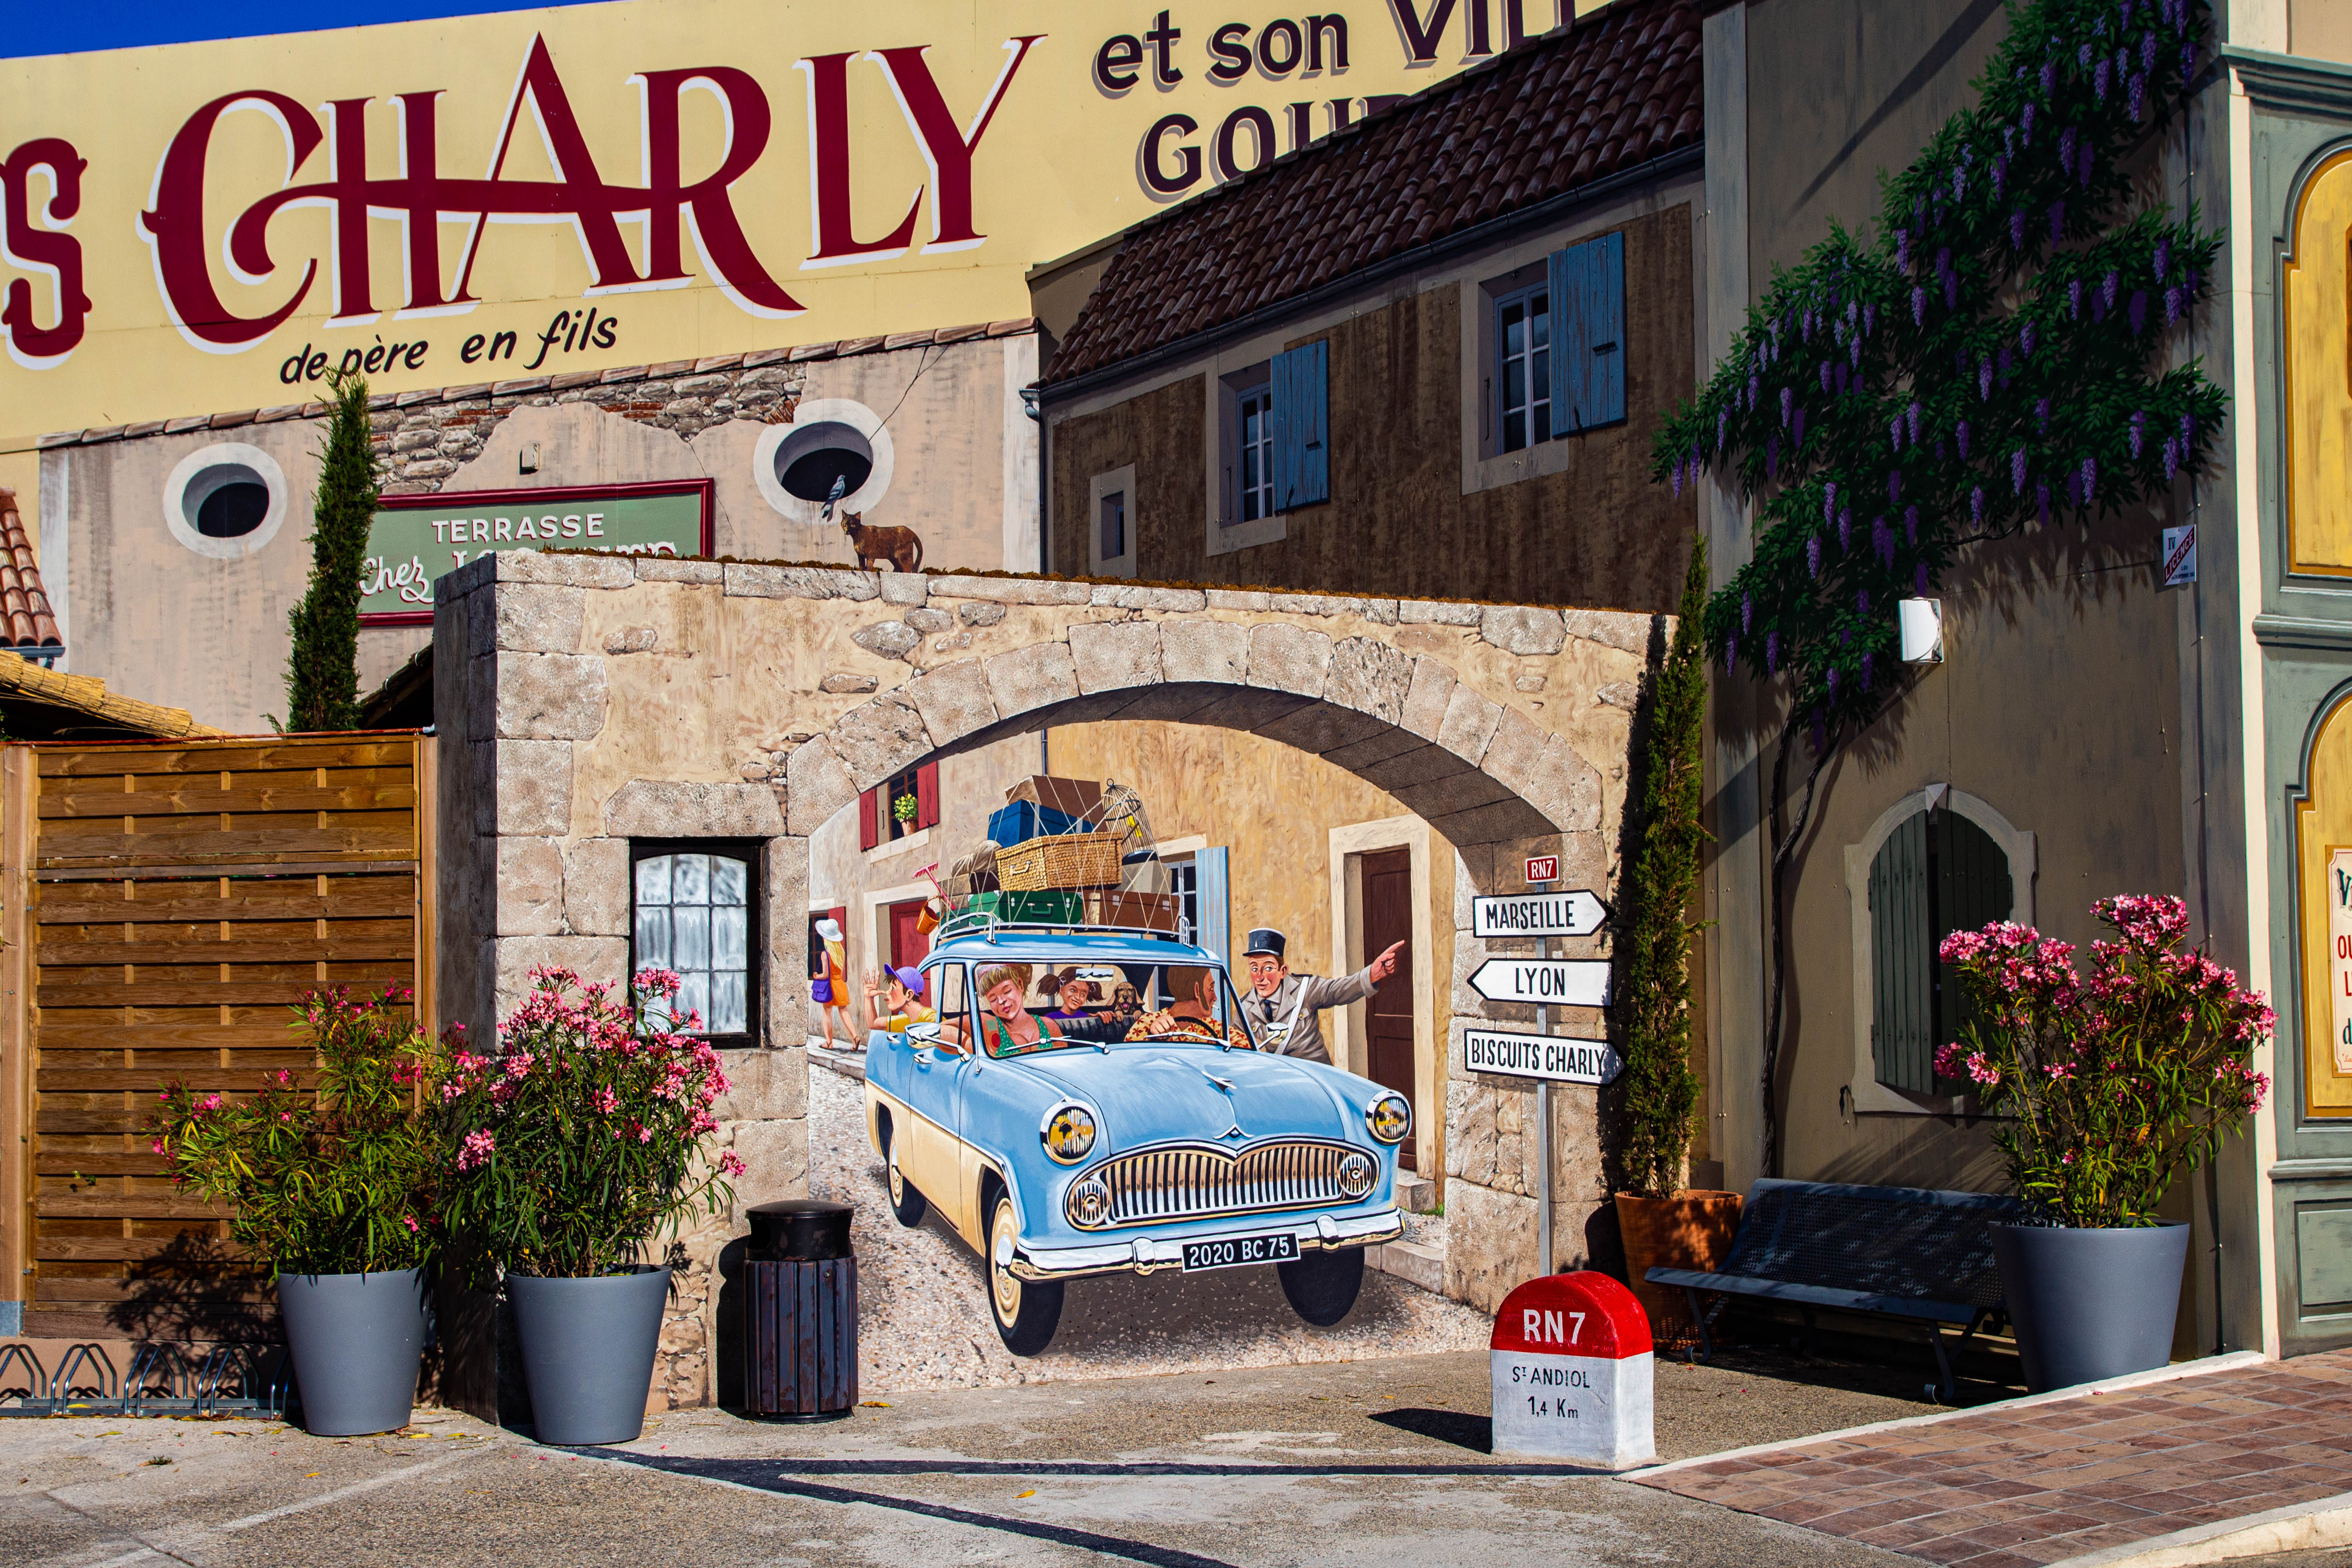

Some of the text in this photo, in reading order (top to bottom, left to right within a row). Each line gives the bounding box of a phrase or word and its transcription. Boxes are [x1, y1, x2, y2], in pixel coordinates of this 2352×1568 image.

[1096, 9, 1184, 91] et
[1209, 13, 1350, 80] son
[141, 31, 1048, 344] CHARLY
[280, 307, 618, 386] de père en fils
[432, 513, 604, 543] TERRASSE
[2168, 537, 2176, 550] IV
[2165, 530, 2194, 579] LICENCE
[358, 555, 434, 604] Chez
[1531, 860, 1553, 878] RN7
[1486, 900, 1575, 930] MARSEILLE
[1515, 967, 1565, 996] LYON
[1471, 1038, 1606, 1076] BISCUITS CHARLY
[1189, 1236, 1290, 1267] 2020 BC 75
[1524, 1309, 1586, 1345] RN7
[1530, 1367, 1590, 1388] ANDIOL
[1527, 1396, 1579, 1419] 1,4 Km
